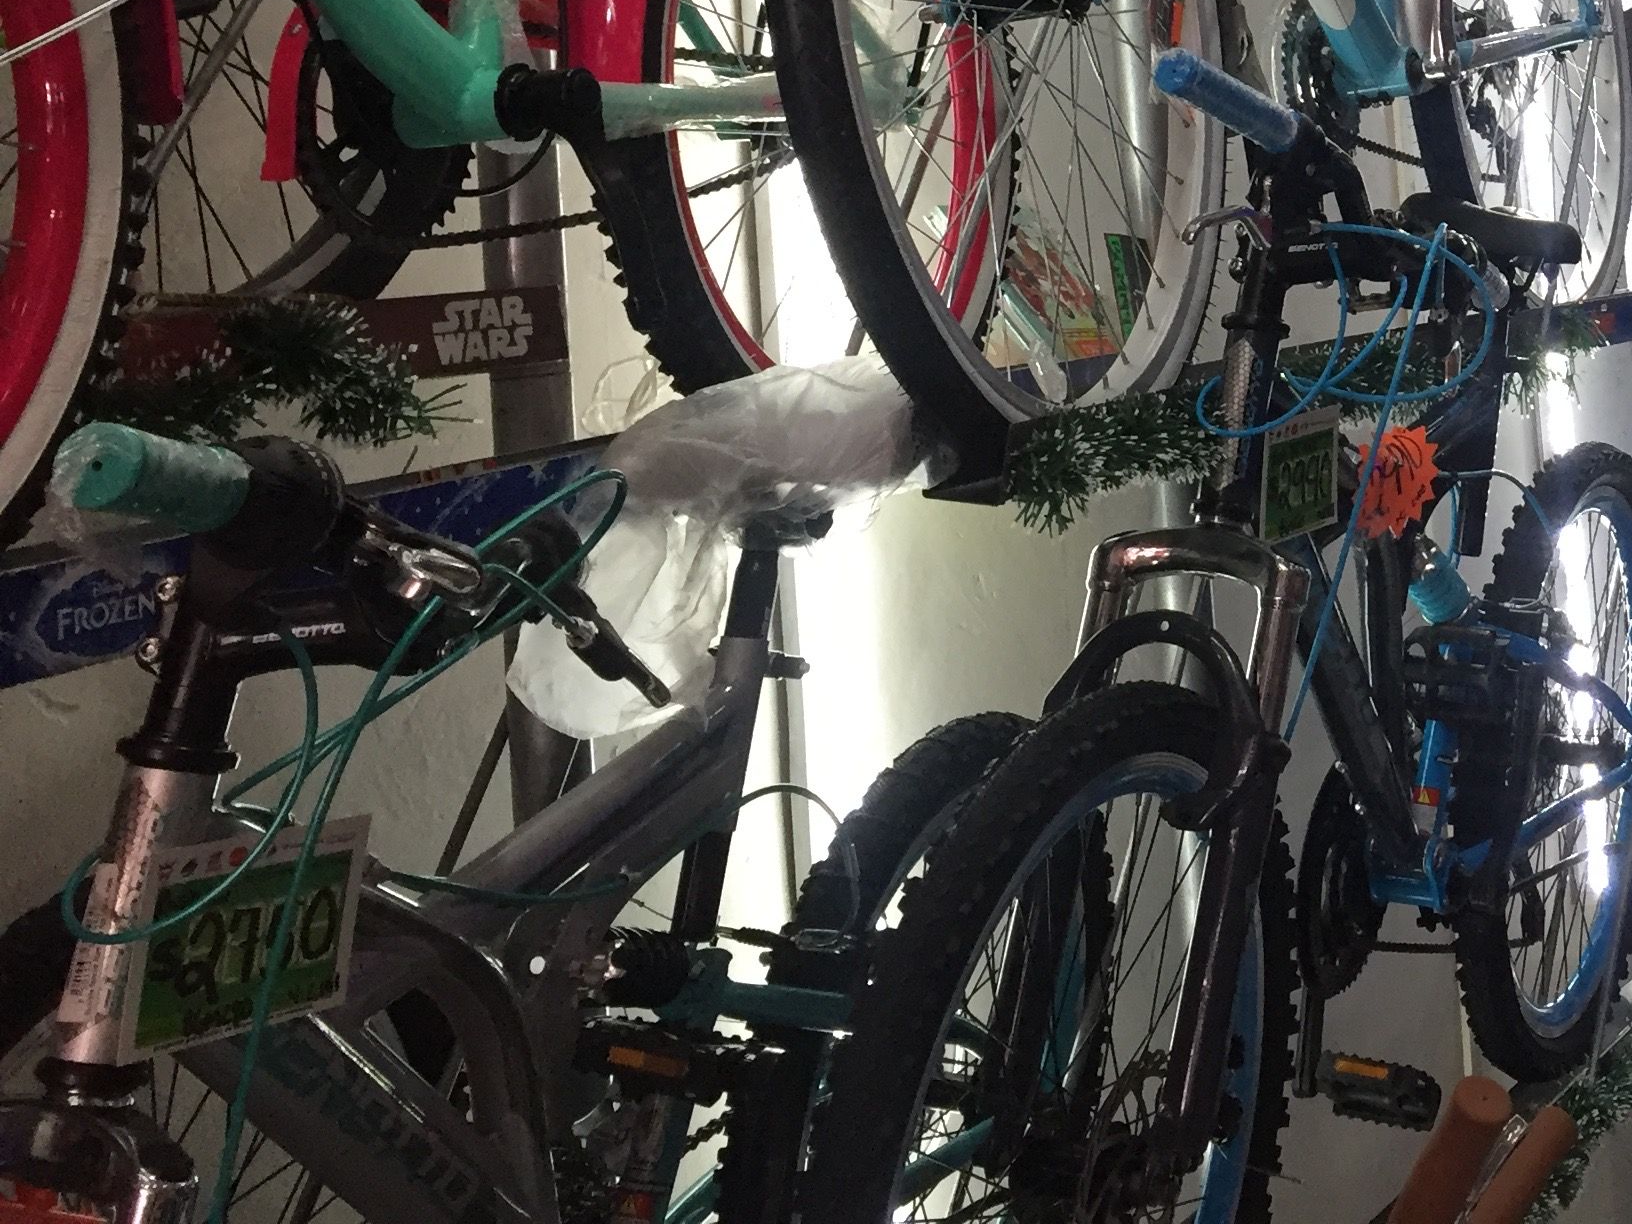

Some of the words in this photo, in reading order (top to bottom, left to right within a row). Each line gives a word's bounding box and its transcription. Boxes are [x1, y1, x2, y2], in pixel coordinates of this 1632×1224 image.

[1287, 241, 1339, 253] BENOTO
[432, 295, 533, 334] STAR
[433, 325, 534, 366] WARS
[56, 593, 158, 641] FROZEN
